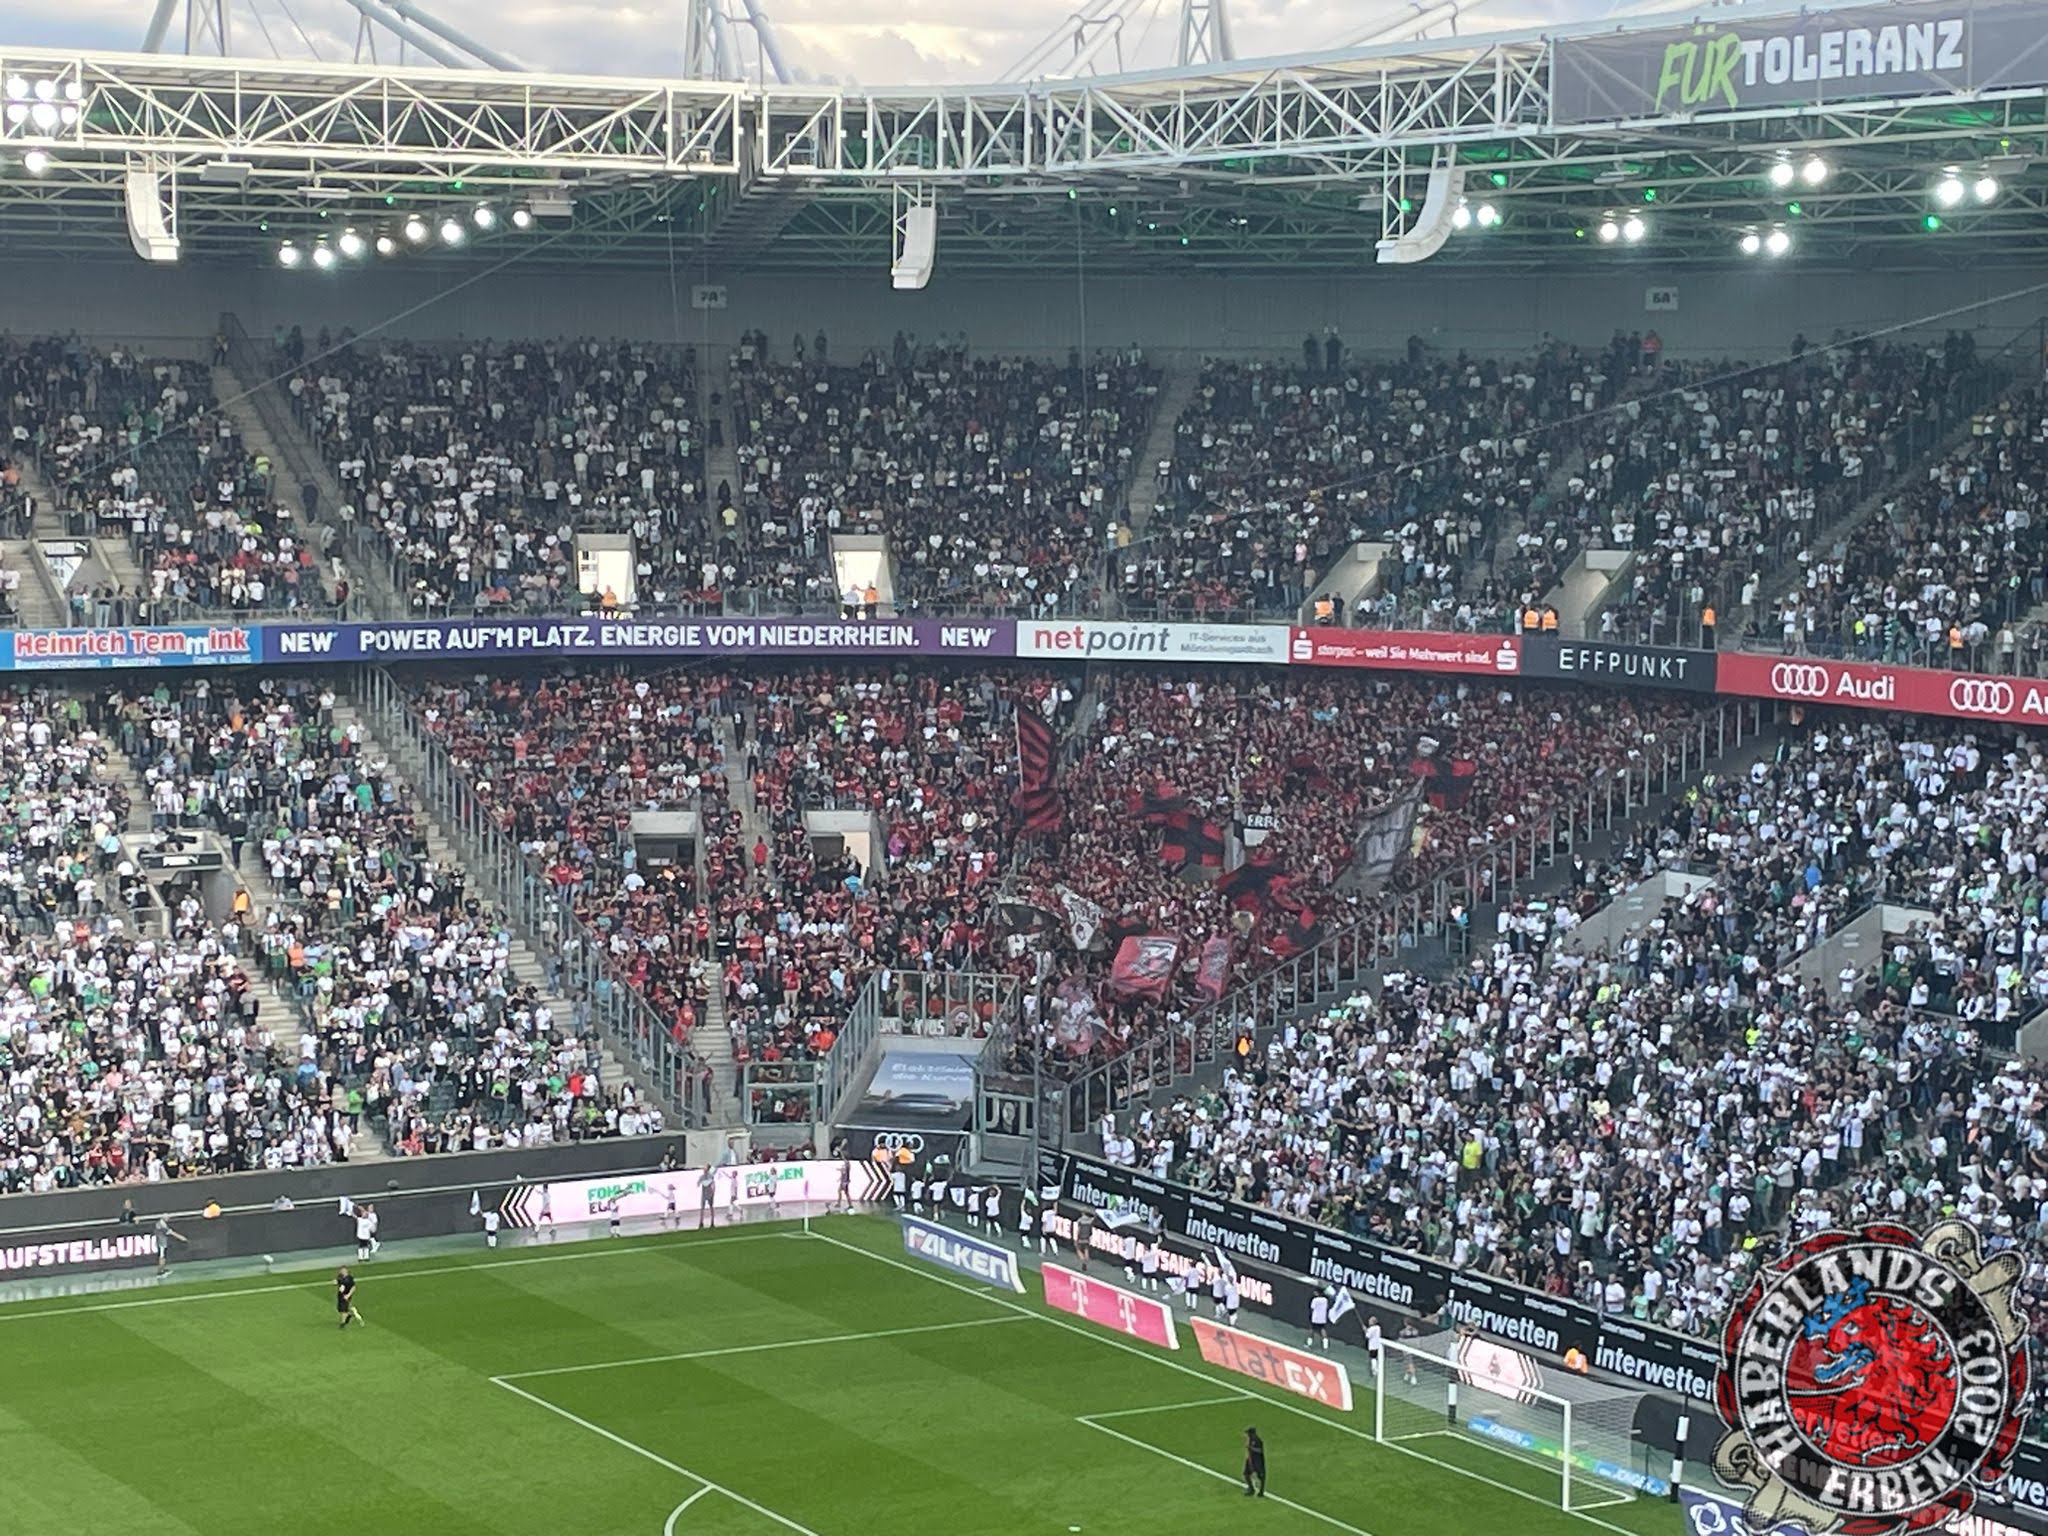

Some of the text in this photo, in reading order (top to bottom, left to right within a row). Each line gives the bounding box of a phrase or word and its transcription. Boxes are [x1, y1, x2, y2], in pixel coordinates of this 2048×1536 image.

[1654, 19, 1965, 112] FÜR TOLERANZ
[15, 627, 250, 657] Heinrich Temmink
[281, 624, 991, 652] NEW POWER AUF'M PLATZ. ENERGIE VOM NIEDERRHEIN. NEW
[1034, 625, 1170, 656] netpoint
[1559, 648, 1688, 680] EFFPUNKT
[1836, 671, 1894, 701] Audi
[908, 1226, 1010, 1283] FALKEN
[1186, 1208, 1280, 1263] interwetten
[1069, 1275, 1089, 1317] T
[1310, 1247, 1413, 1304] interwetten
[1118, 1291, 1137, 1334] T
